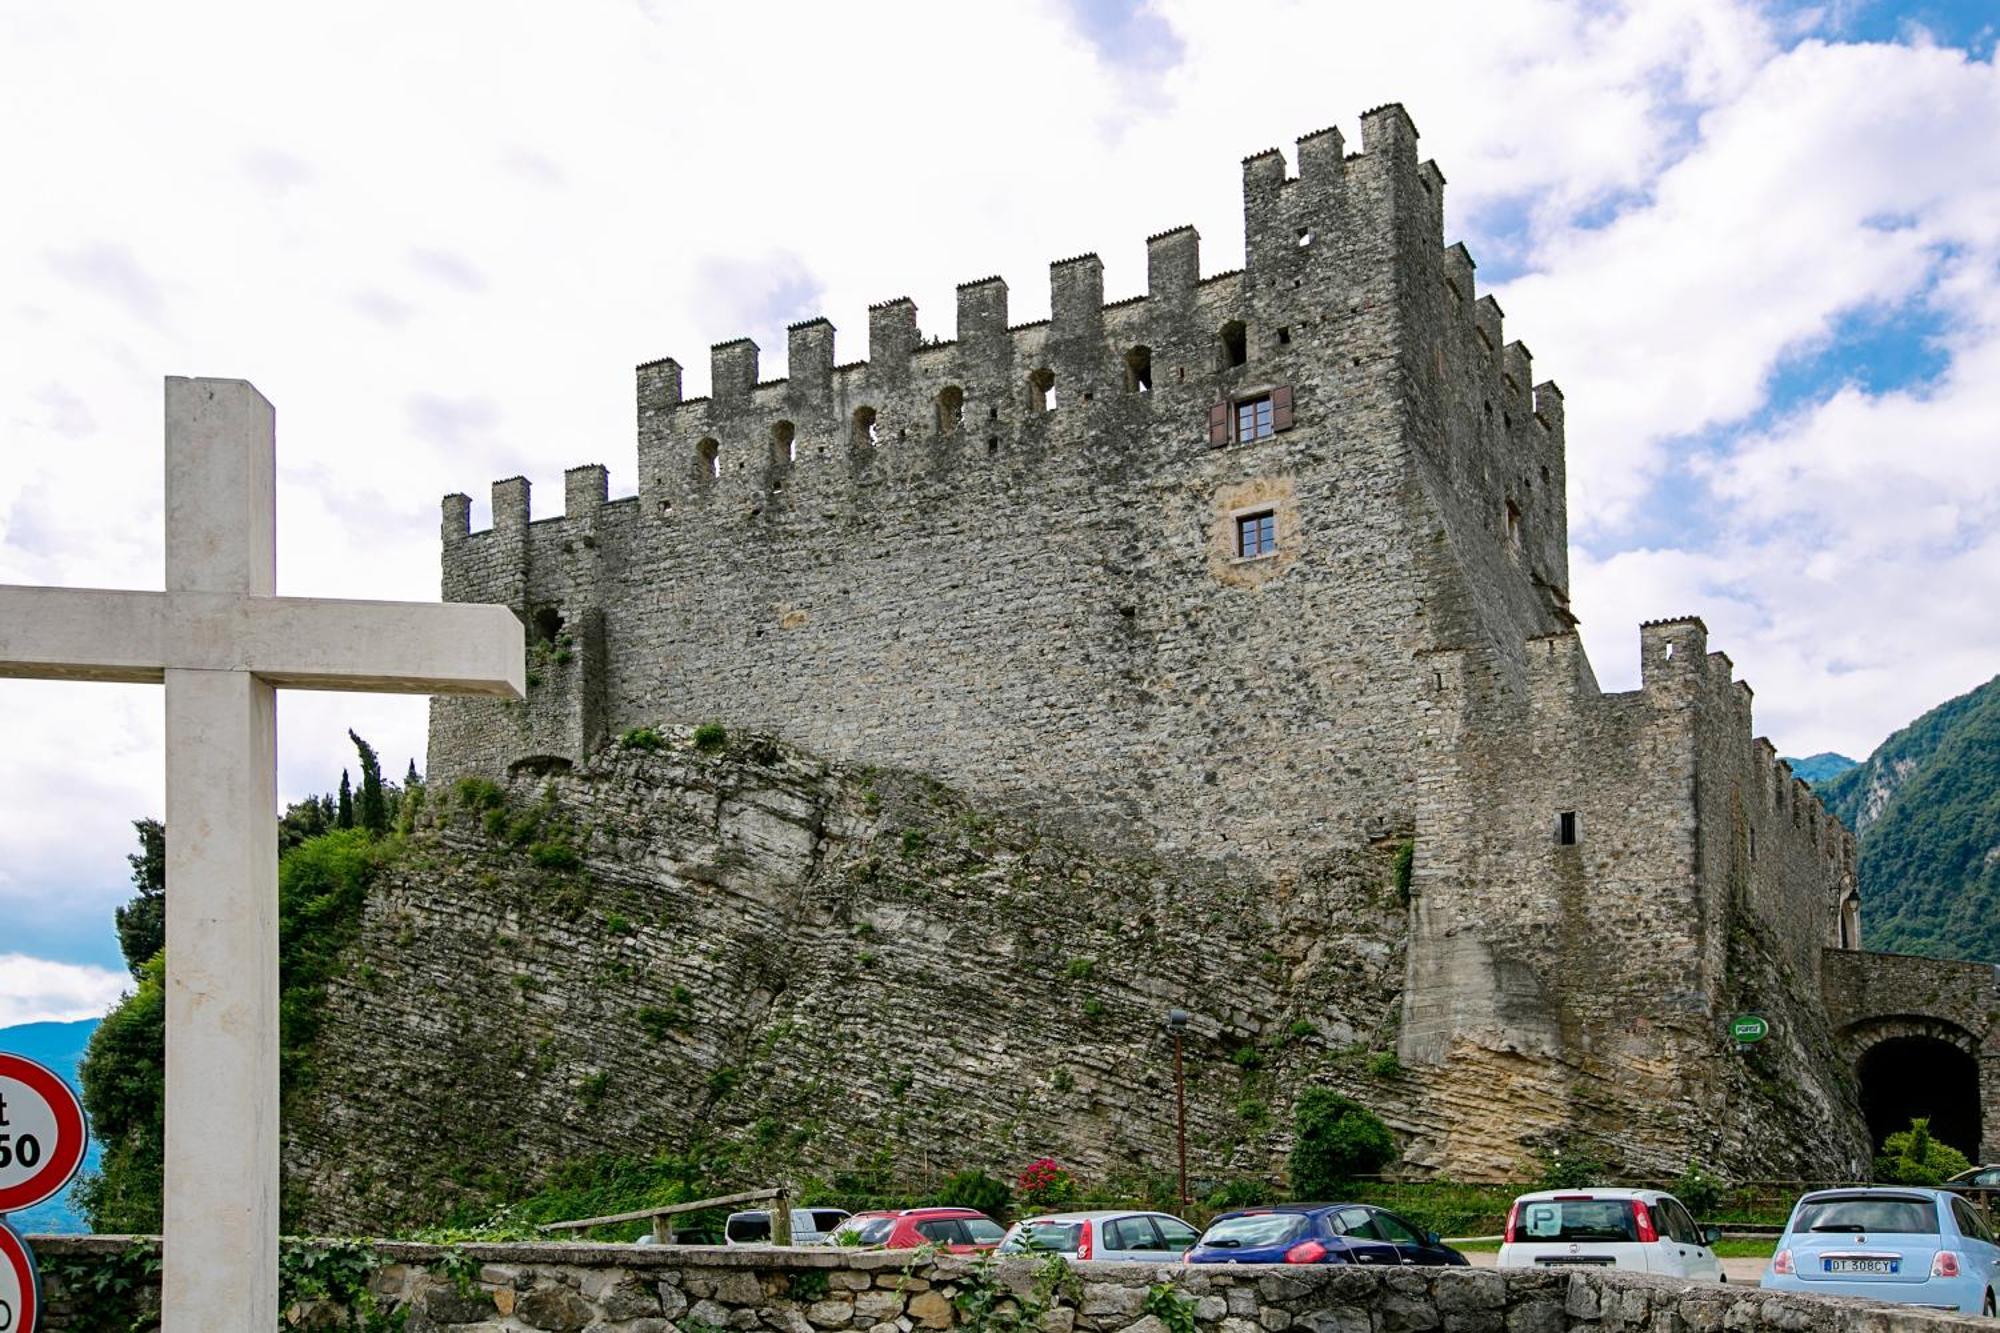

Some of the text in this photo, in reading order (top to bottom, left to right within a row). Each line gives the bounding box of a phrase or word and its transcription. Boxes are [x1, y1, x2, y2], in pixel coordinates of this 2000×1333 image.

[1533, 1209, 1554, 1230] P
[1833, 1260, 1889, 1271] DT 308CY
